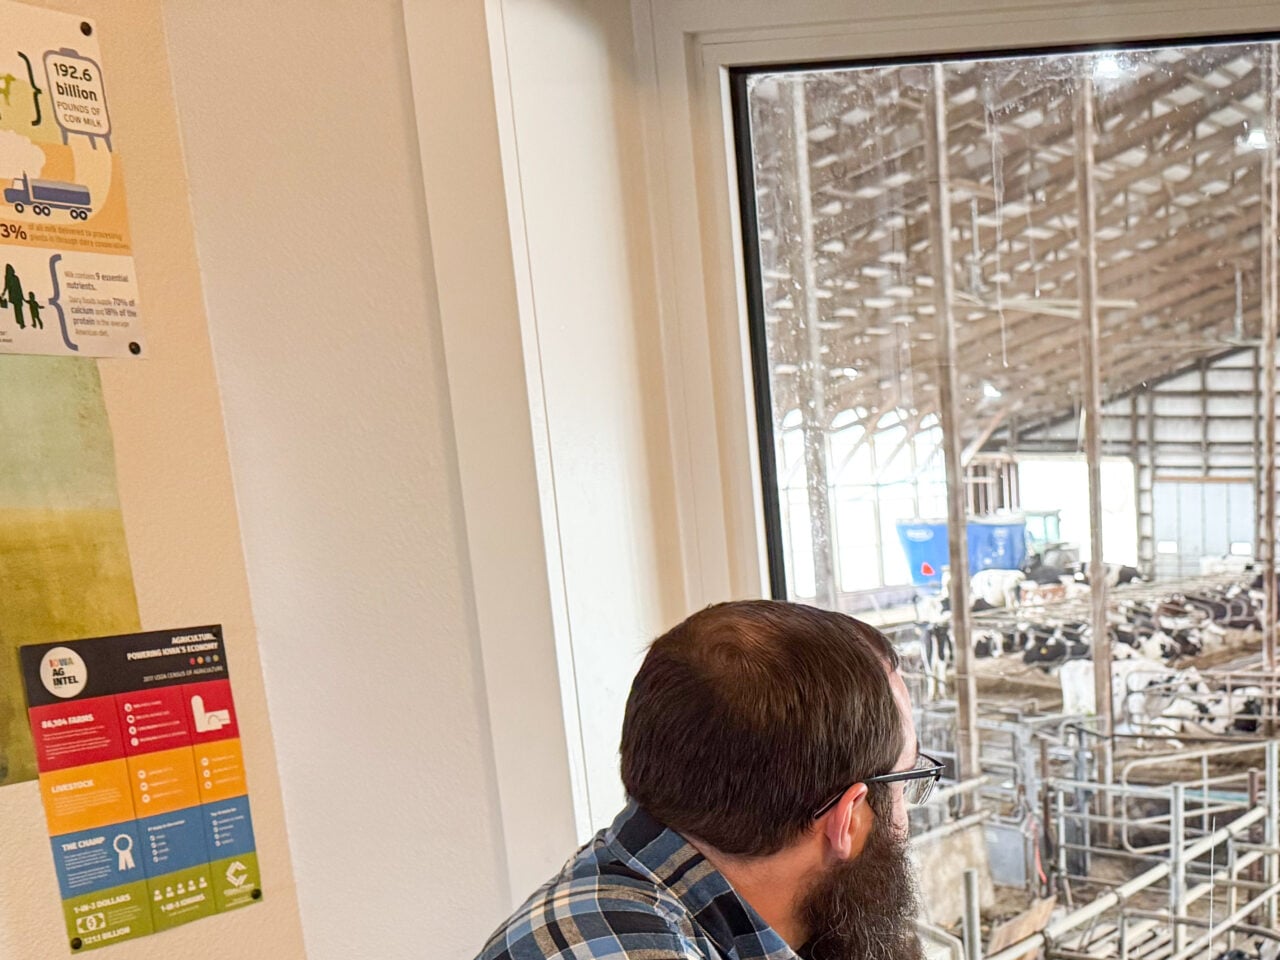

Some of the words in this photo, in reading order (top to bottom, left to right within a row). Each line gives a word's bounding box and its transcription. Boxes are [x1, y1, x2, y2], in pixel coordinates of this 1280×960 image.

[53, 63, 92, 81] 192.6
[56, 82, 97, 101] billion
[57, 101, 89, 114] POUNDS
[91, 107, 100, 116] OF
[64, 114, 81, 124] COW
[83, 118, 102, 128] MILK
[49, 657, 74, 668] IOWA
[52, 668, 65, 677] AG
[53, 675, 79, 686] INTEL
[61, 841, 78, 852] THE
[96, 893, 131, 908] DOLLARS
